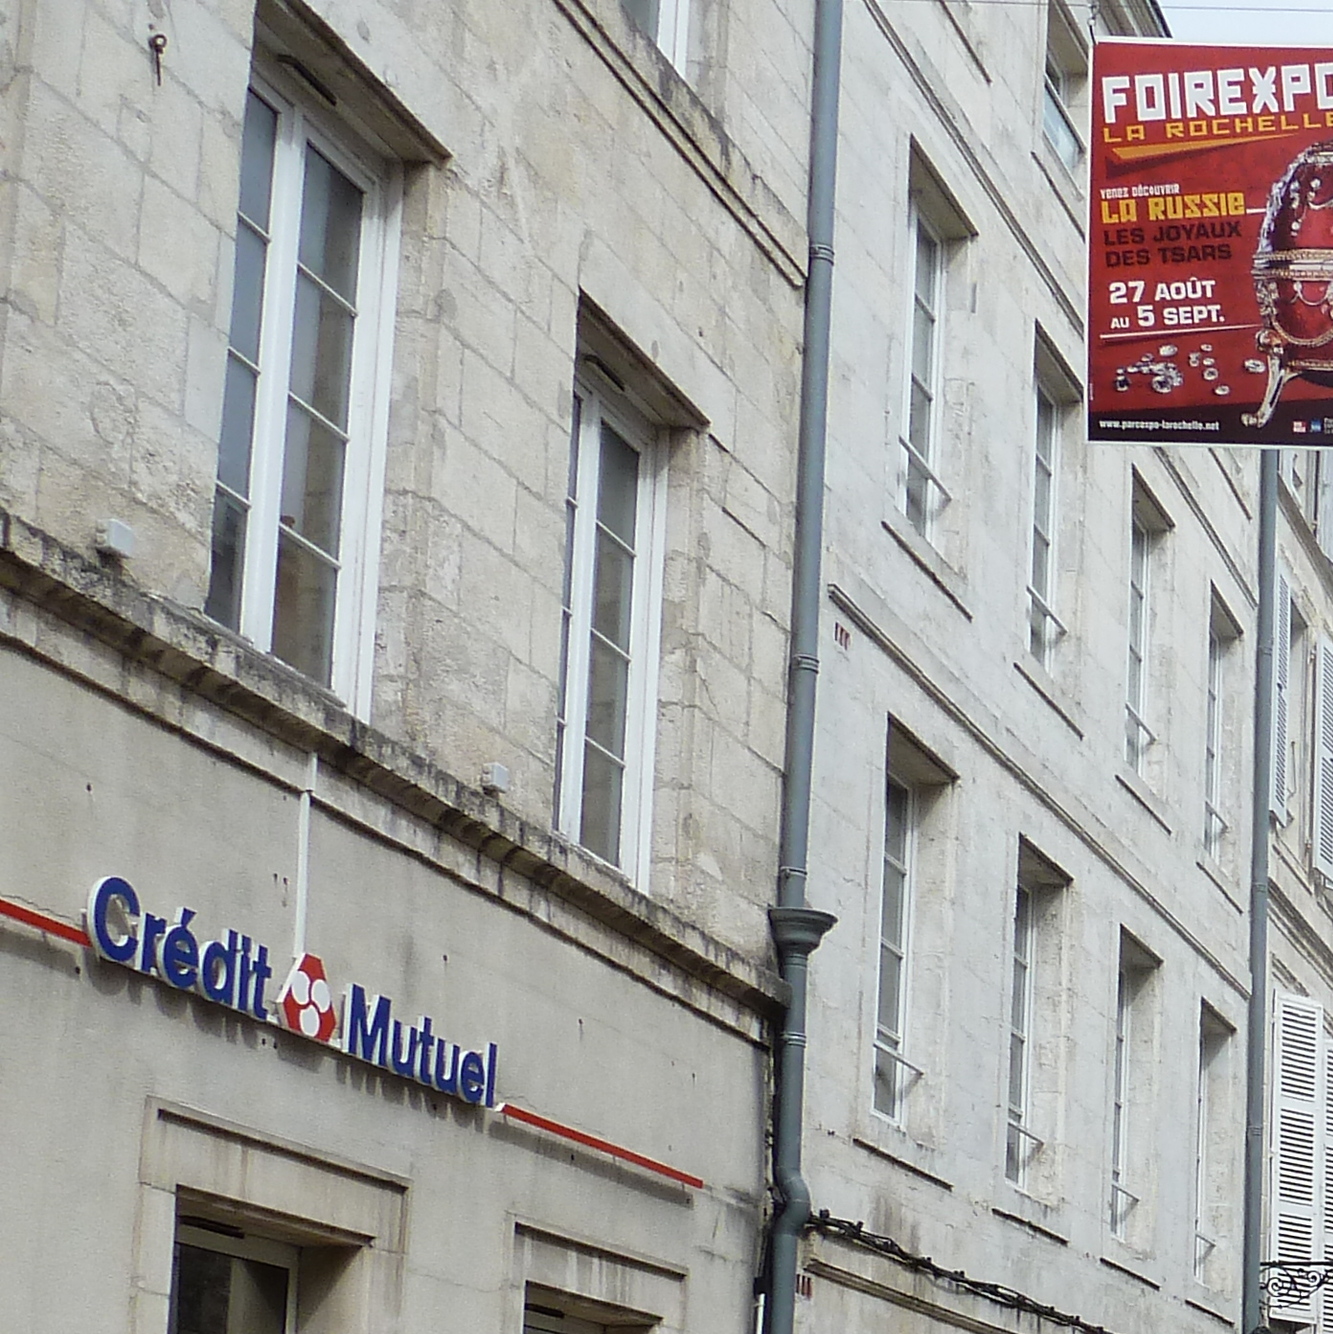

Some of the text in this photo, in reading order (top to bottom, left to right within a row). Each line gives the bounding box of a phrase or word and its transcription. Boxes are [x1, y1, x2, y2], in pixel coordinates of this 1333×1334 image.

[1103, 124, 1146, 144] LA
[1101, 192, 1245, 224] LA RUSSIE
[1104, 221, 1242, 246] LES JOYAUX
[1105, 243, 1232, 268] DES TSARS
[1109, 277, 1216, 304] 27 AOÛT
[1110, 304, 1225, 329] AU 5 SEPT.
[89, 876, 498, 1109] Crédit Mutuel
